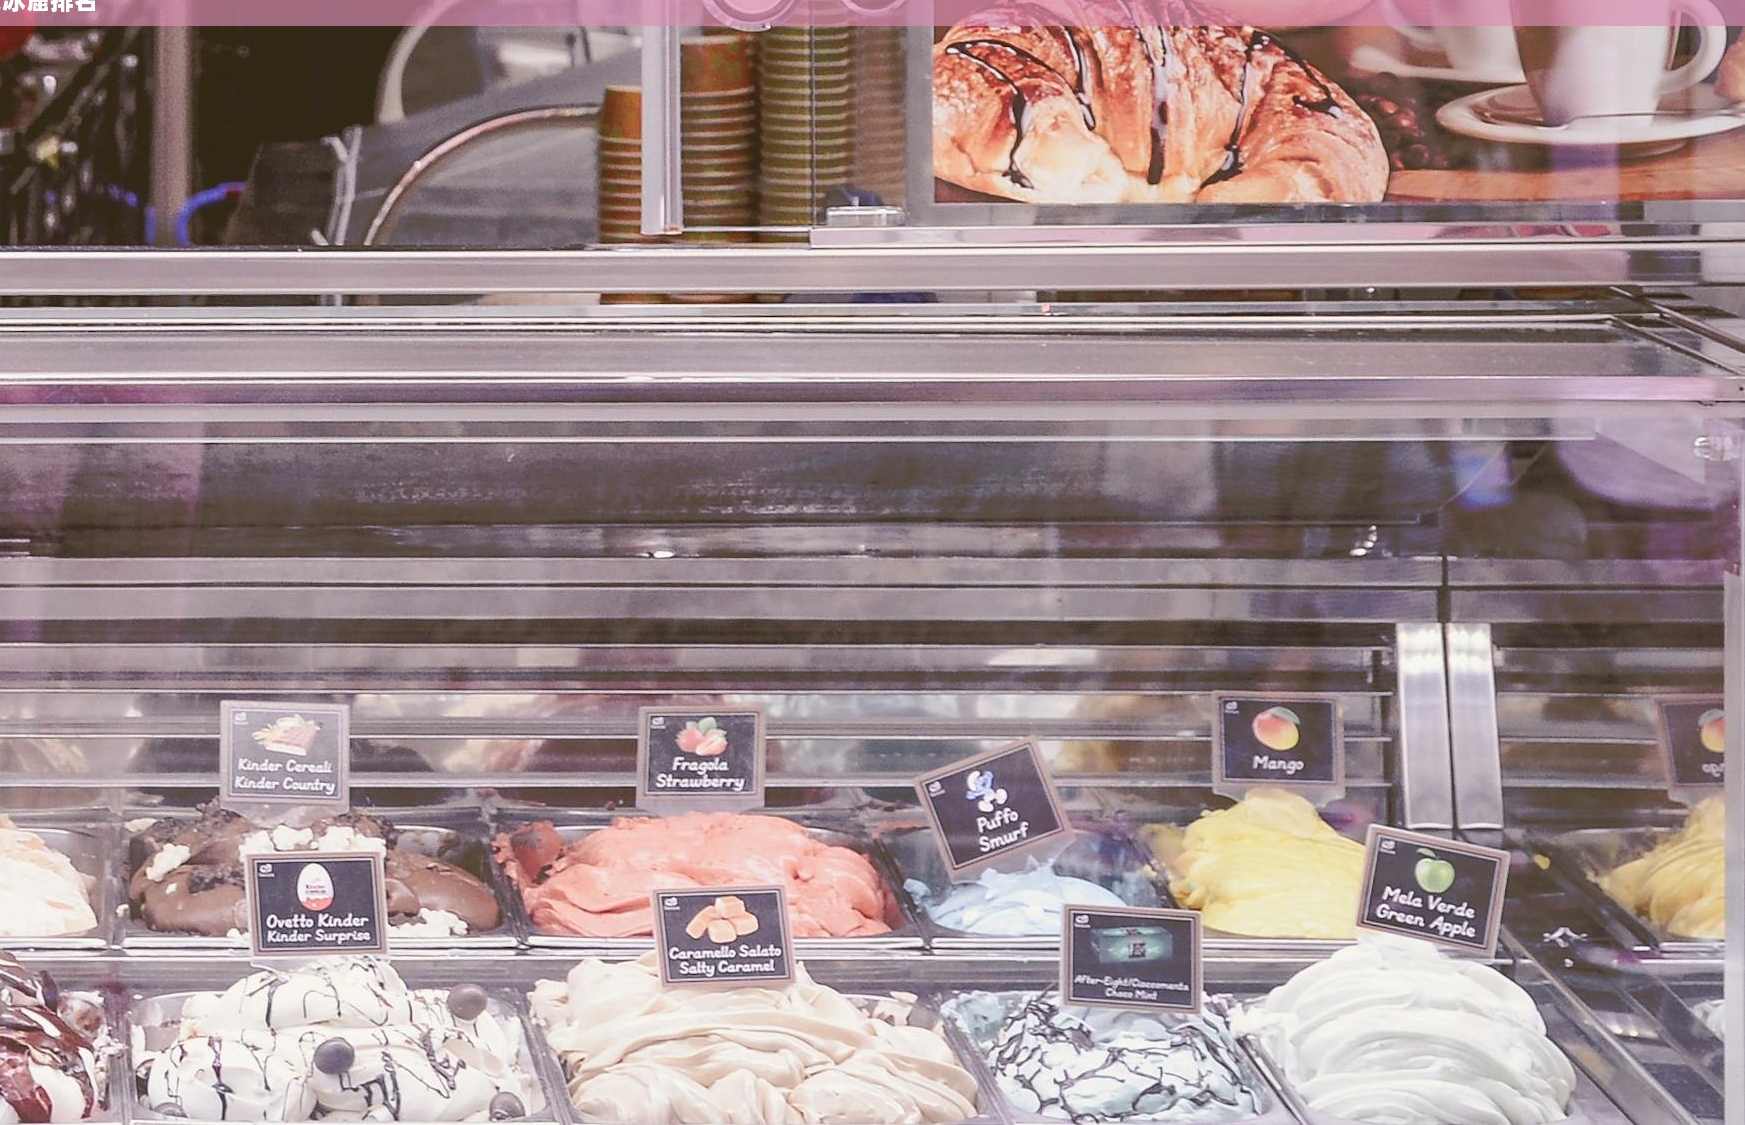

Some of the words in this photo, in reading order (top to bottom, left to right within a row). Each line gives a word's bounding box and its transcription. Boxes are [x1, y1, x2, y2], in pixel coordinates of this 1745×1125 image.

[237, 757, 283, 772] Kinder
[286, 758, 333, 773] Cereali
[672, 756, 730, 775] Fragola
[1253, 755, 1305, 775] Mango
[234, 775, 279, 790] Kinder
[282, 776, 336, 795] Country
[655, 773, 746, 792] Strawberry
[976, 807, 1019, 833] Puffo
[978, 821, 1030, 852] Smurf
[1382, 885, 1423, 908] Mela
[1427, 895, 1476, 919] Verde
[265, 913, 315, 929] Ovetto
[317, 912, 370, 928] Kinder
[1375, 903, 1425, 927] Green
[1428, 915, 1476, 938] Apple
[266, 929, 313, 943] Kinder
[314, 928, 372, 945] Surprise
[668, 945, 737, 960] Caramello
[738, 944, 783, 958] Salato
[678, 961, 716, 977] Salty
[717, 959, 776, 974] Caramel
